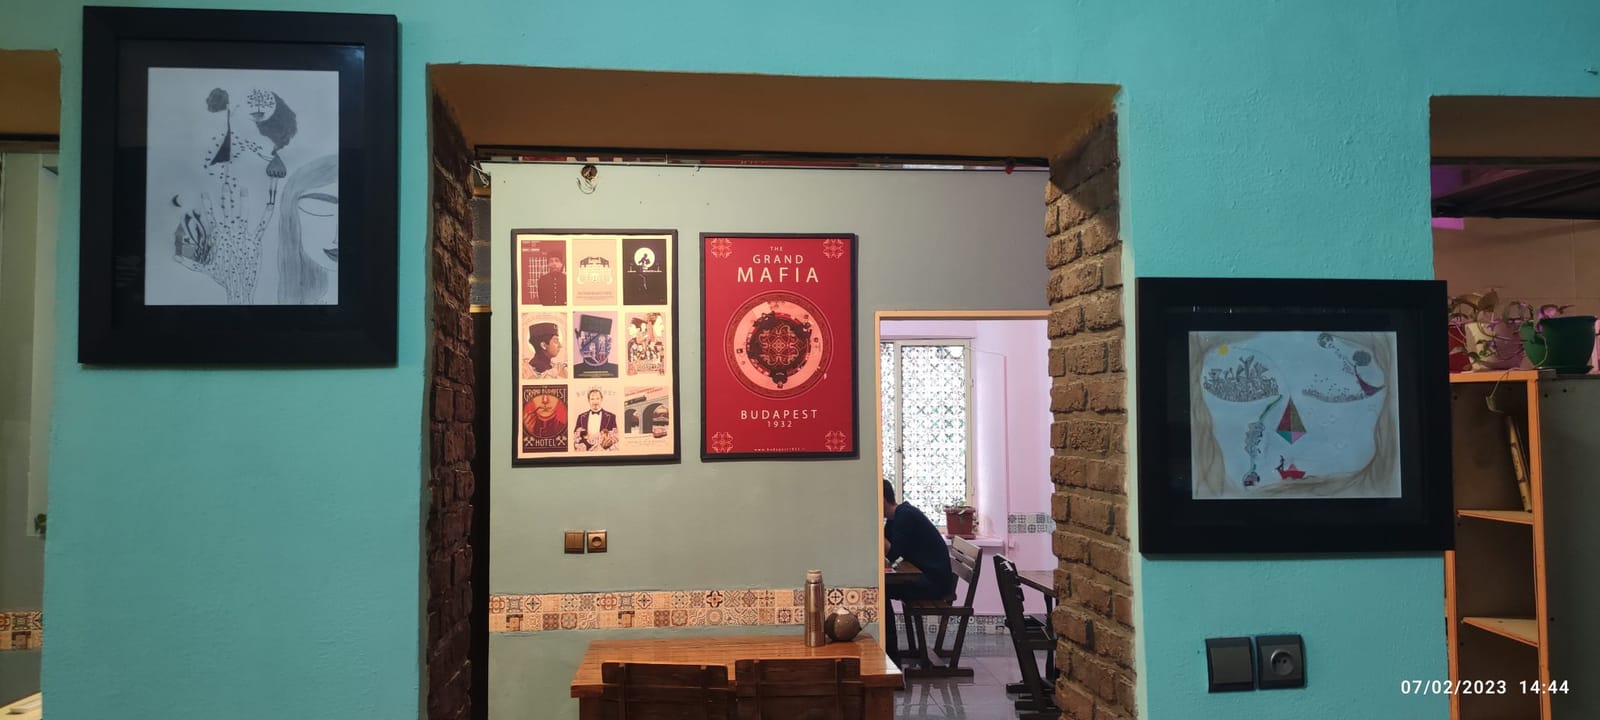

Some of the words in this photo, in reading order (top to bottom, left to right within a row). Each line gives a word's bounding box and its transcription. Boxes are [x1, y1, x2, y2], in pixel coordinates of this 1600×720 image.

[752, 254, 804, 265] GRAND
[737, 266, 819, 283] MAFIA
[740, 409, 817, 420] BUDAPEST
[767, 420, 793, 428] 1932
[535, 438, 556, 447] HOTEL
